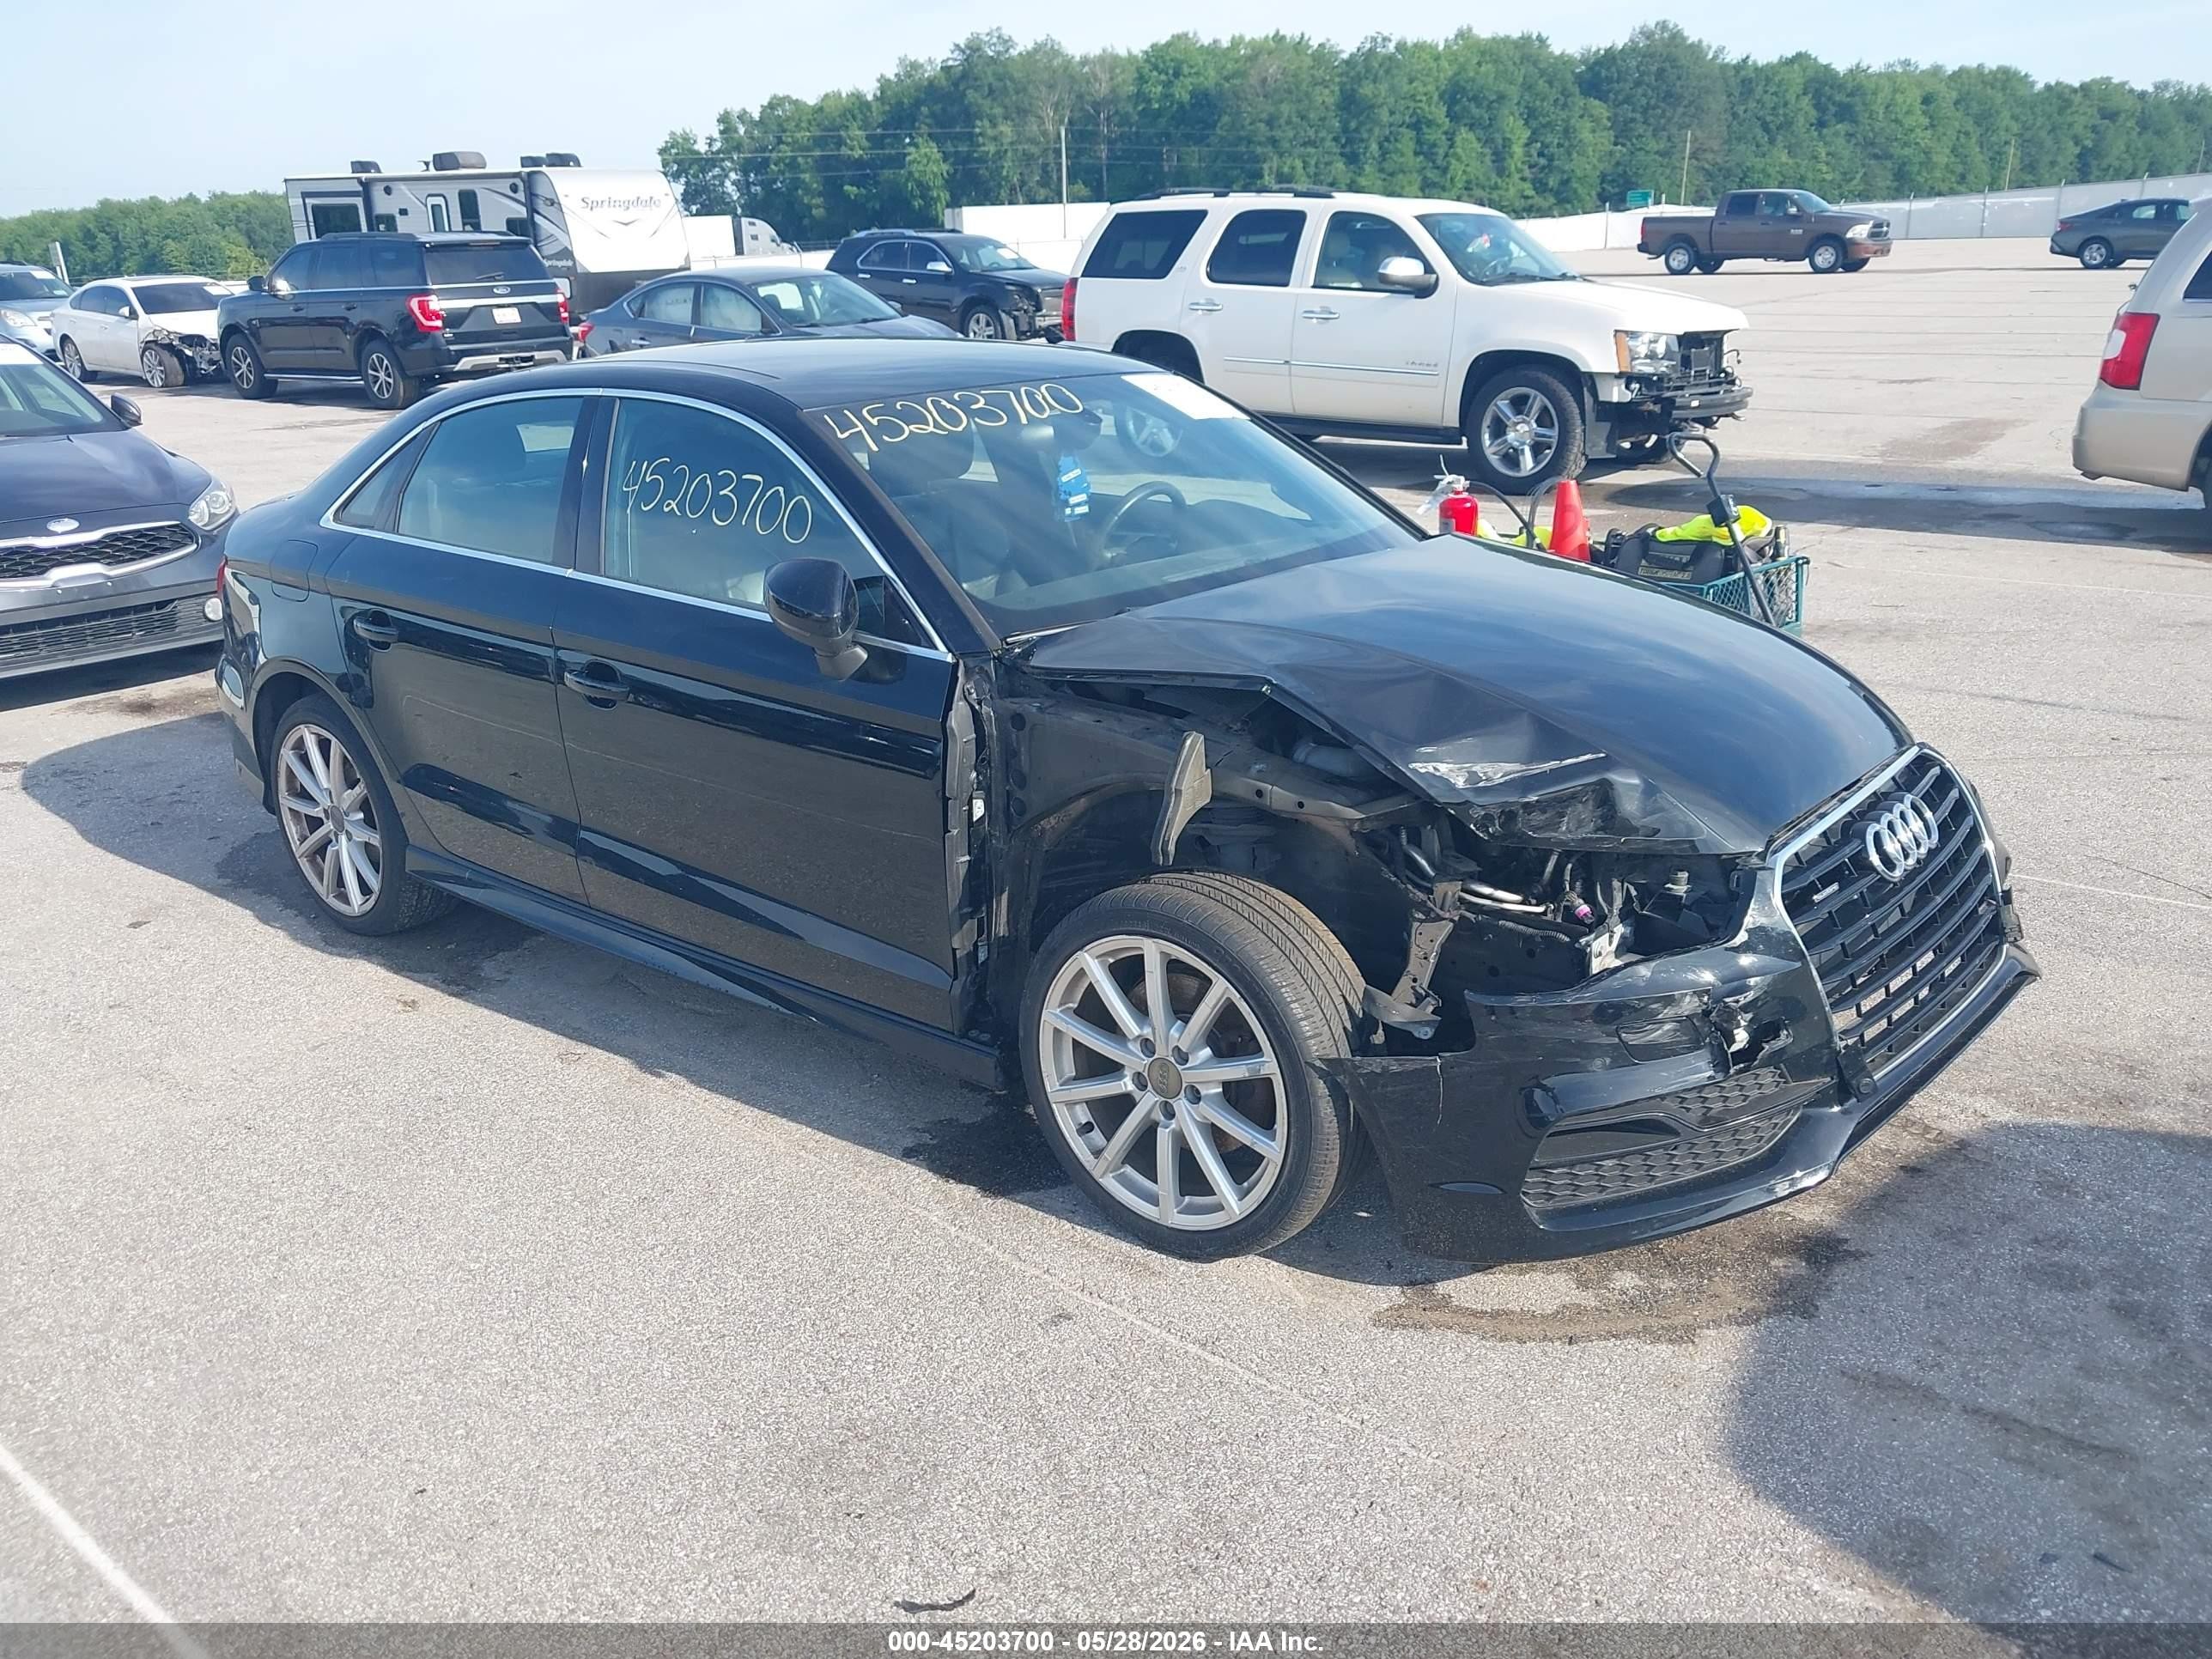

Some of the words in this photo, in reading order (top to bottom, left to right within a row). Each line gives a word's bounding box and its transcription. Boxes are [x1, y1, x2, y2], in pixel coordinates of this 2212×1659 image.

[580, 196, 661, 212] Springdale
[823, 383, 1084, 452] 45203700
[622, 457, 812, 544] 45203700
